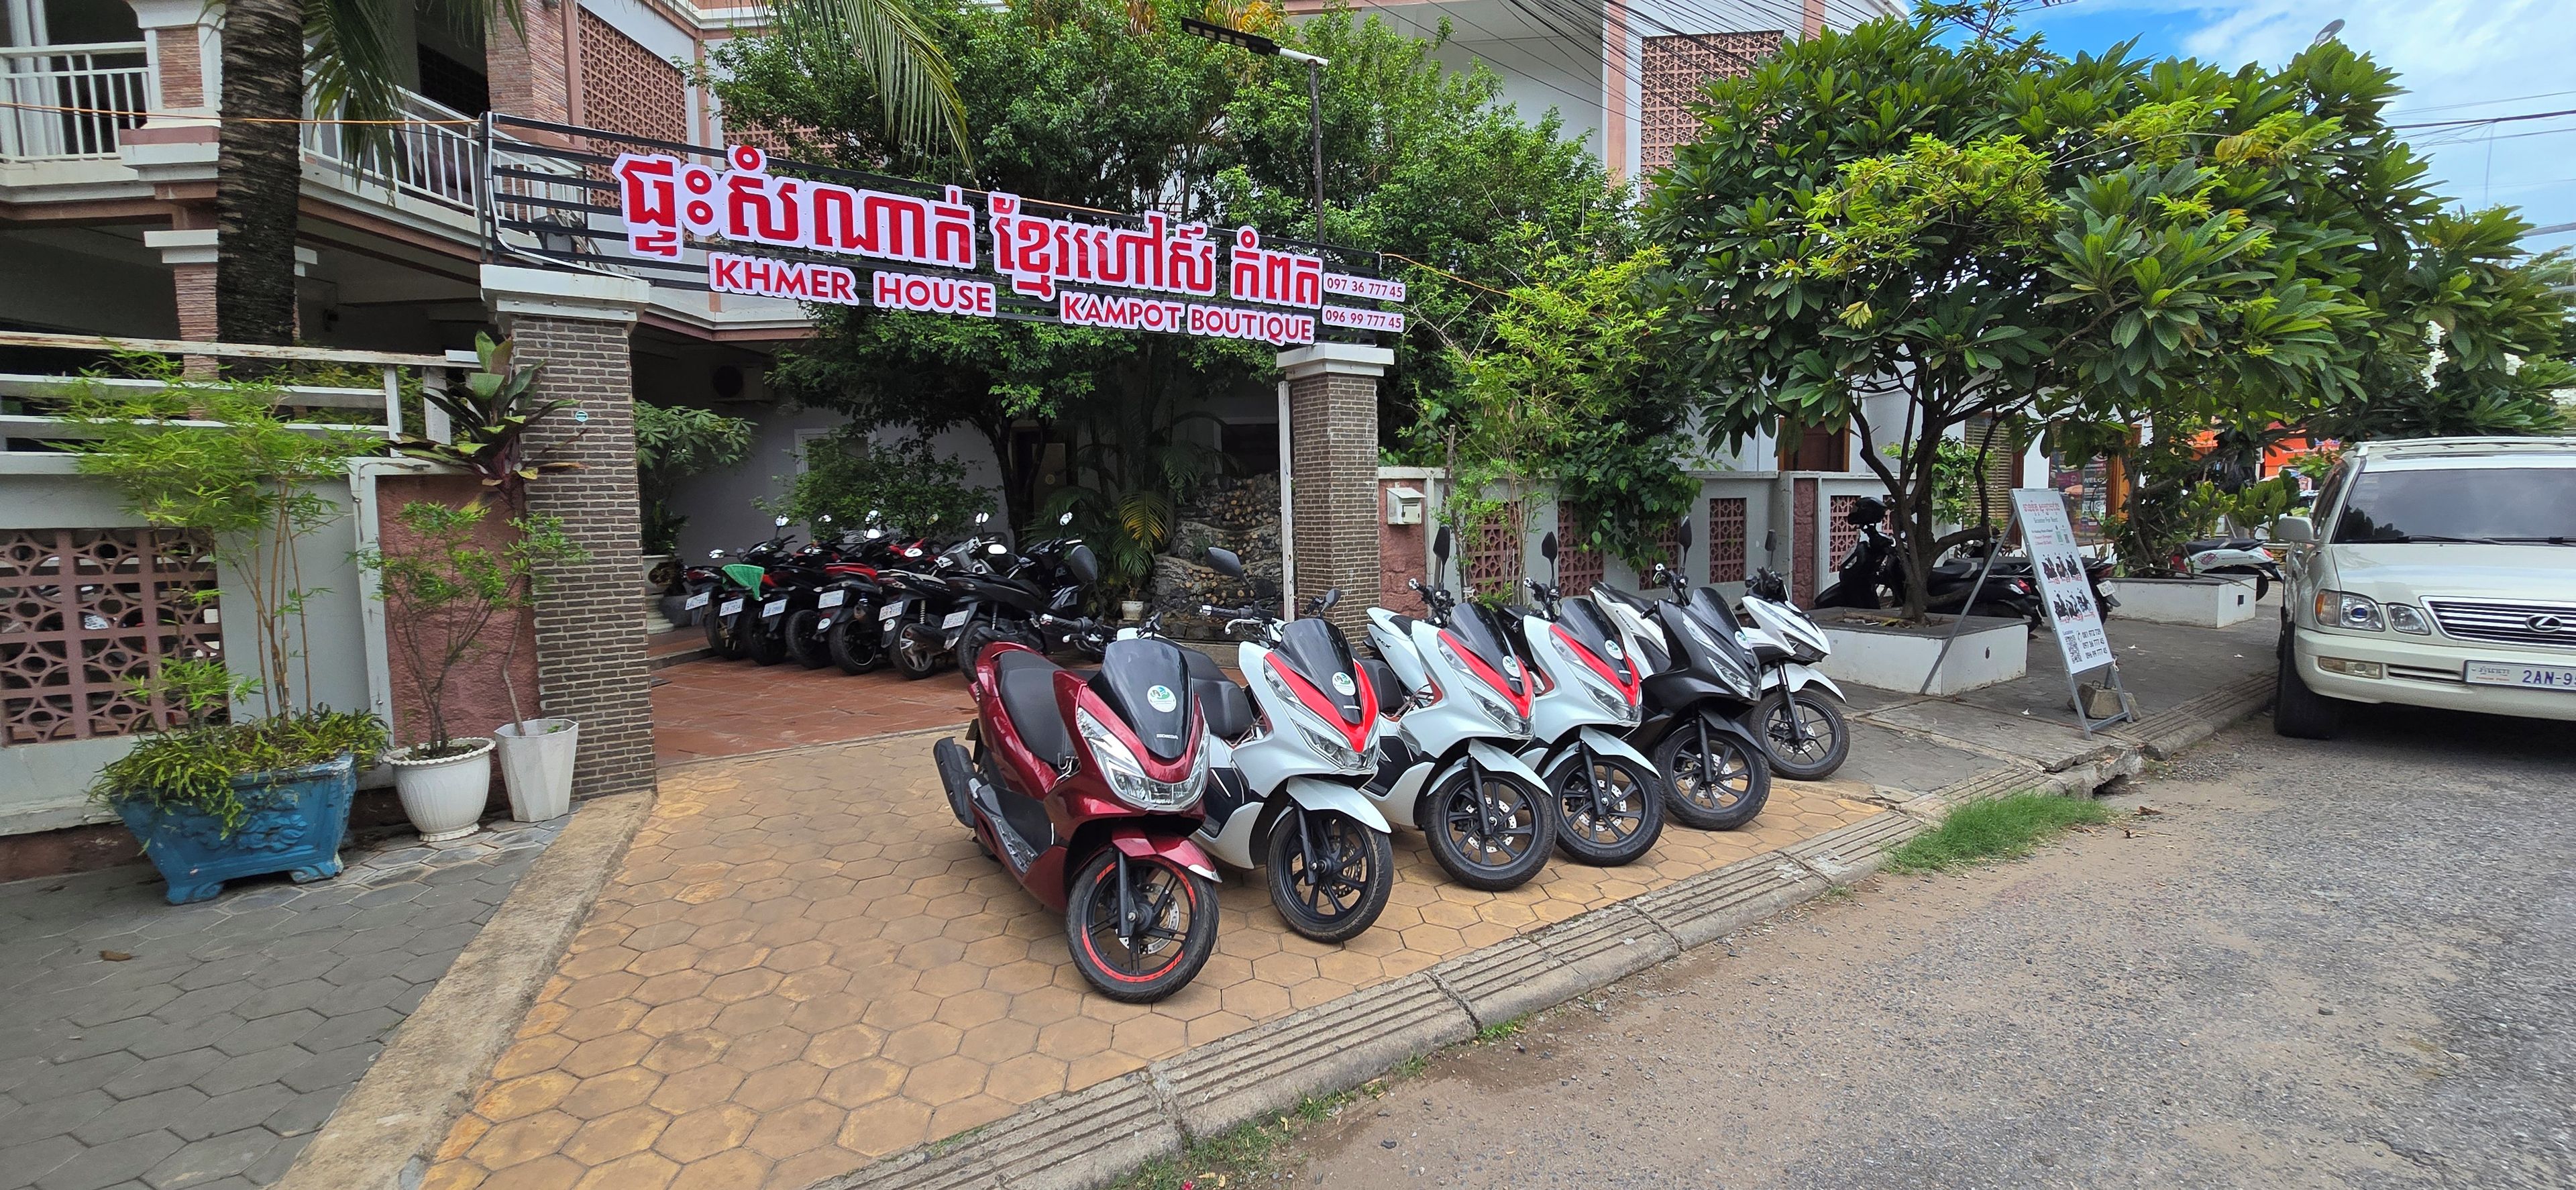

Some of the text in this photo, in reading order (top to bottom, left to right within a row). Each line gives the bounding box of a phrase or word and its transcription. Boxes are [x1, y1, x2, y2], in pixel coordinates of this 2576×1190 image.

[1234, 230, 1320, 305] កំពត
[1328, 277, 1403, 298] 097 36 777 45
[715, 258, 1314, 343] KHMER HOUSE KAMPOT BOUTIQUE
[1326, 309, 1401, 329] 096 99 777 45
